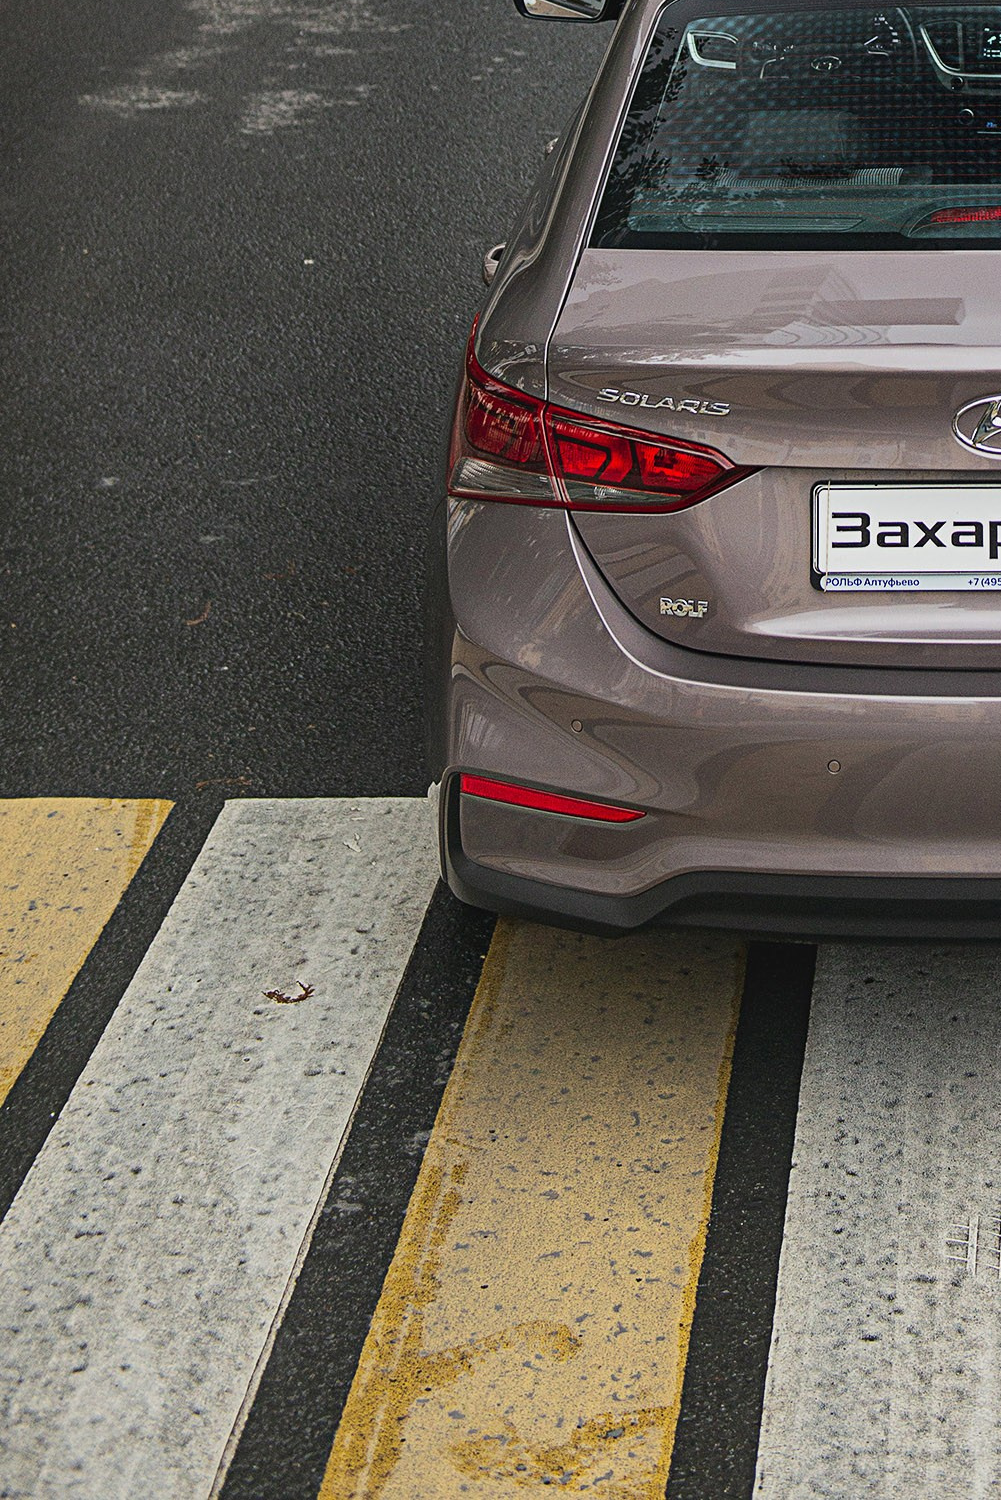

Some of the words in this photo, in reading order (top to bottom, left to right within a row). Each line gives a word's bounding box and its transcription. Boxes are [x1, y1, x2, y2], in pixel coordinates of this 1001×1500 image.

[596, 387, 732, 416] SOLARIS
[826, 577, 863, 588] РОЛЬФ
[864, 577, 920, 590] Алтуфьево
[967, 577, 979, 587] +7
[659, 597, 709, 619] ROLF
